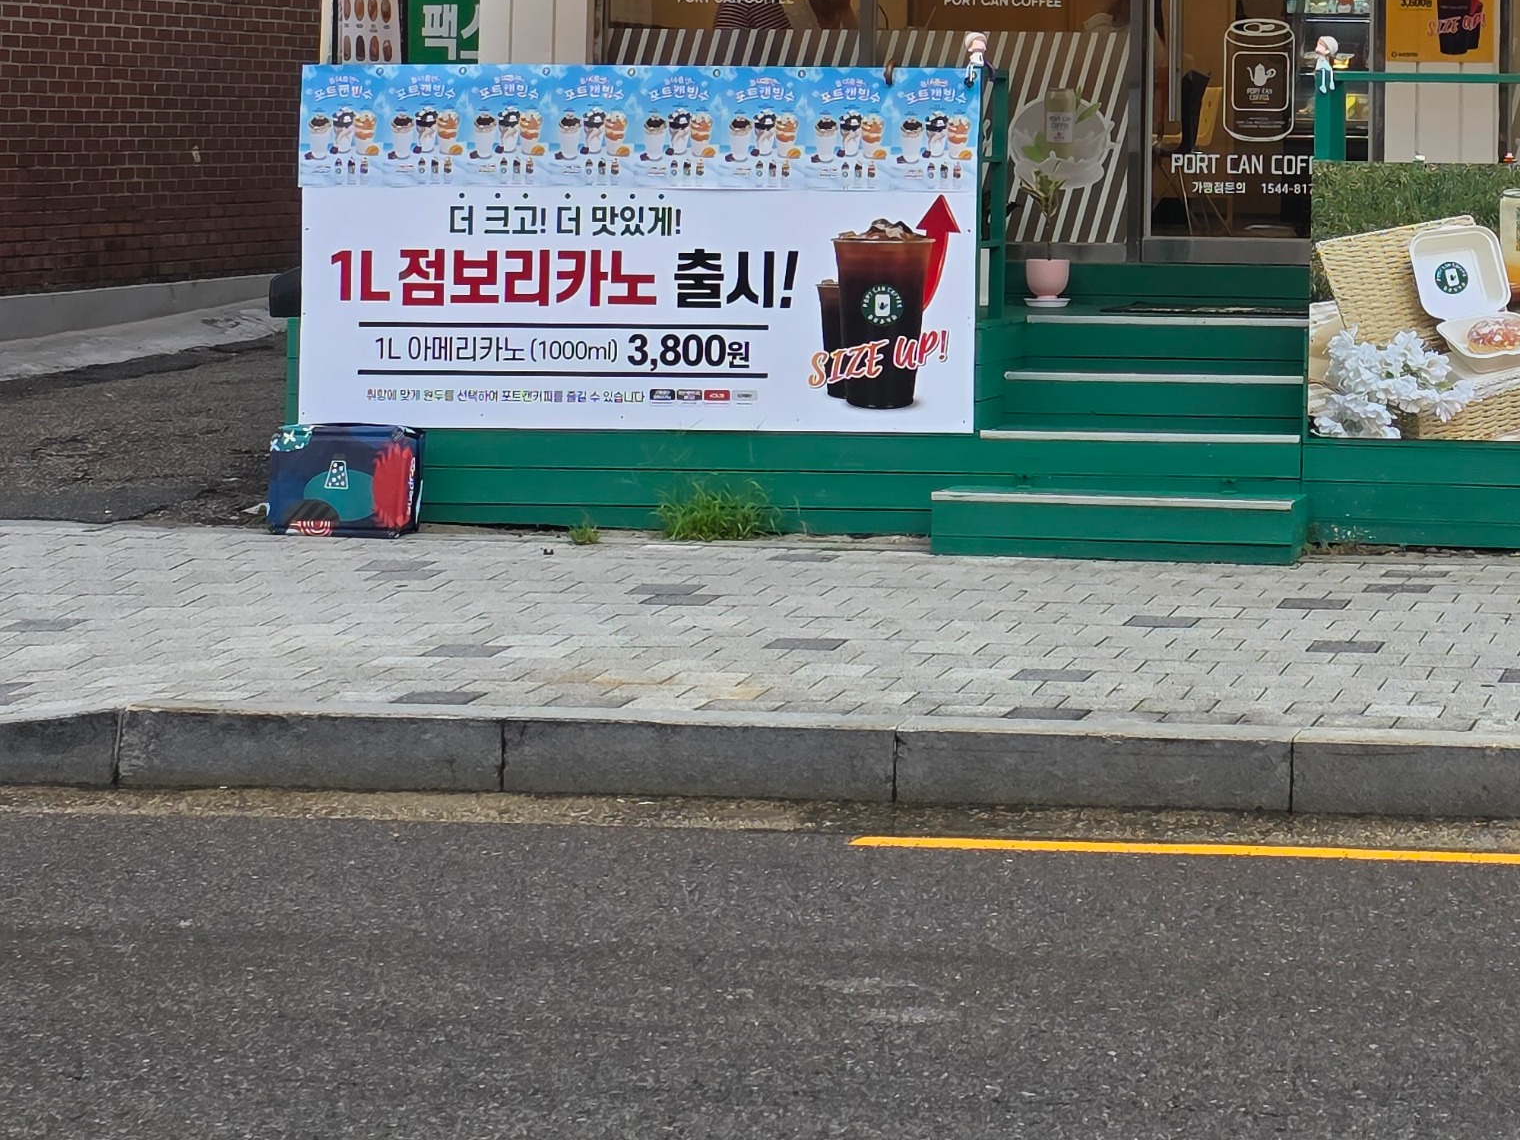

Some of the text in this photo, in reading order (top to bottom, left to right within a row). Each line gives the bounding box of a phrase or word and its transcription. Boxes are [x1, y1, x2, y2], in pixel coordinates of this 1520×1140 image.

[1171, 153, 1316, 175] PORT CAN COFF
[1261, 183, 1314, 195] 1544-817
[449, 205, 682, 237] 더 크고! 더 맛있게!
[673, 248, 800, 310] 출시!
[375, 337, 401, 362] 1L
[627, 333, 750, 371] 3,800원
[808, 330, 950, 388] SIZE UP!
[457, 389, 499, 403] 선택하여
[603, 390, 645, 404] 있습니다
